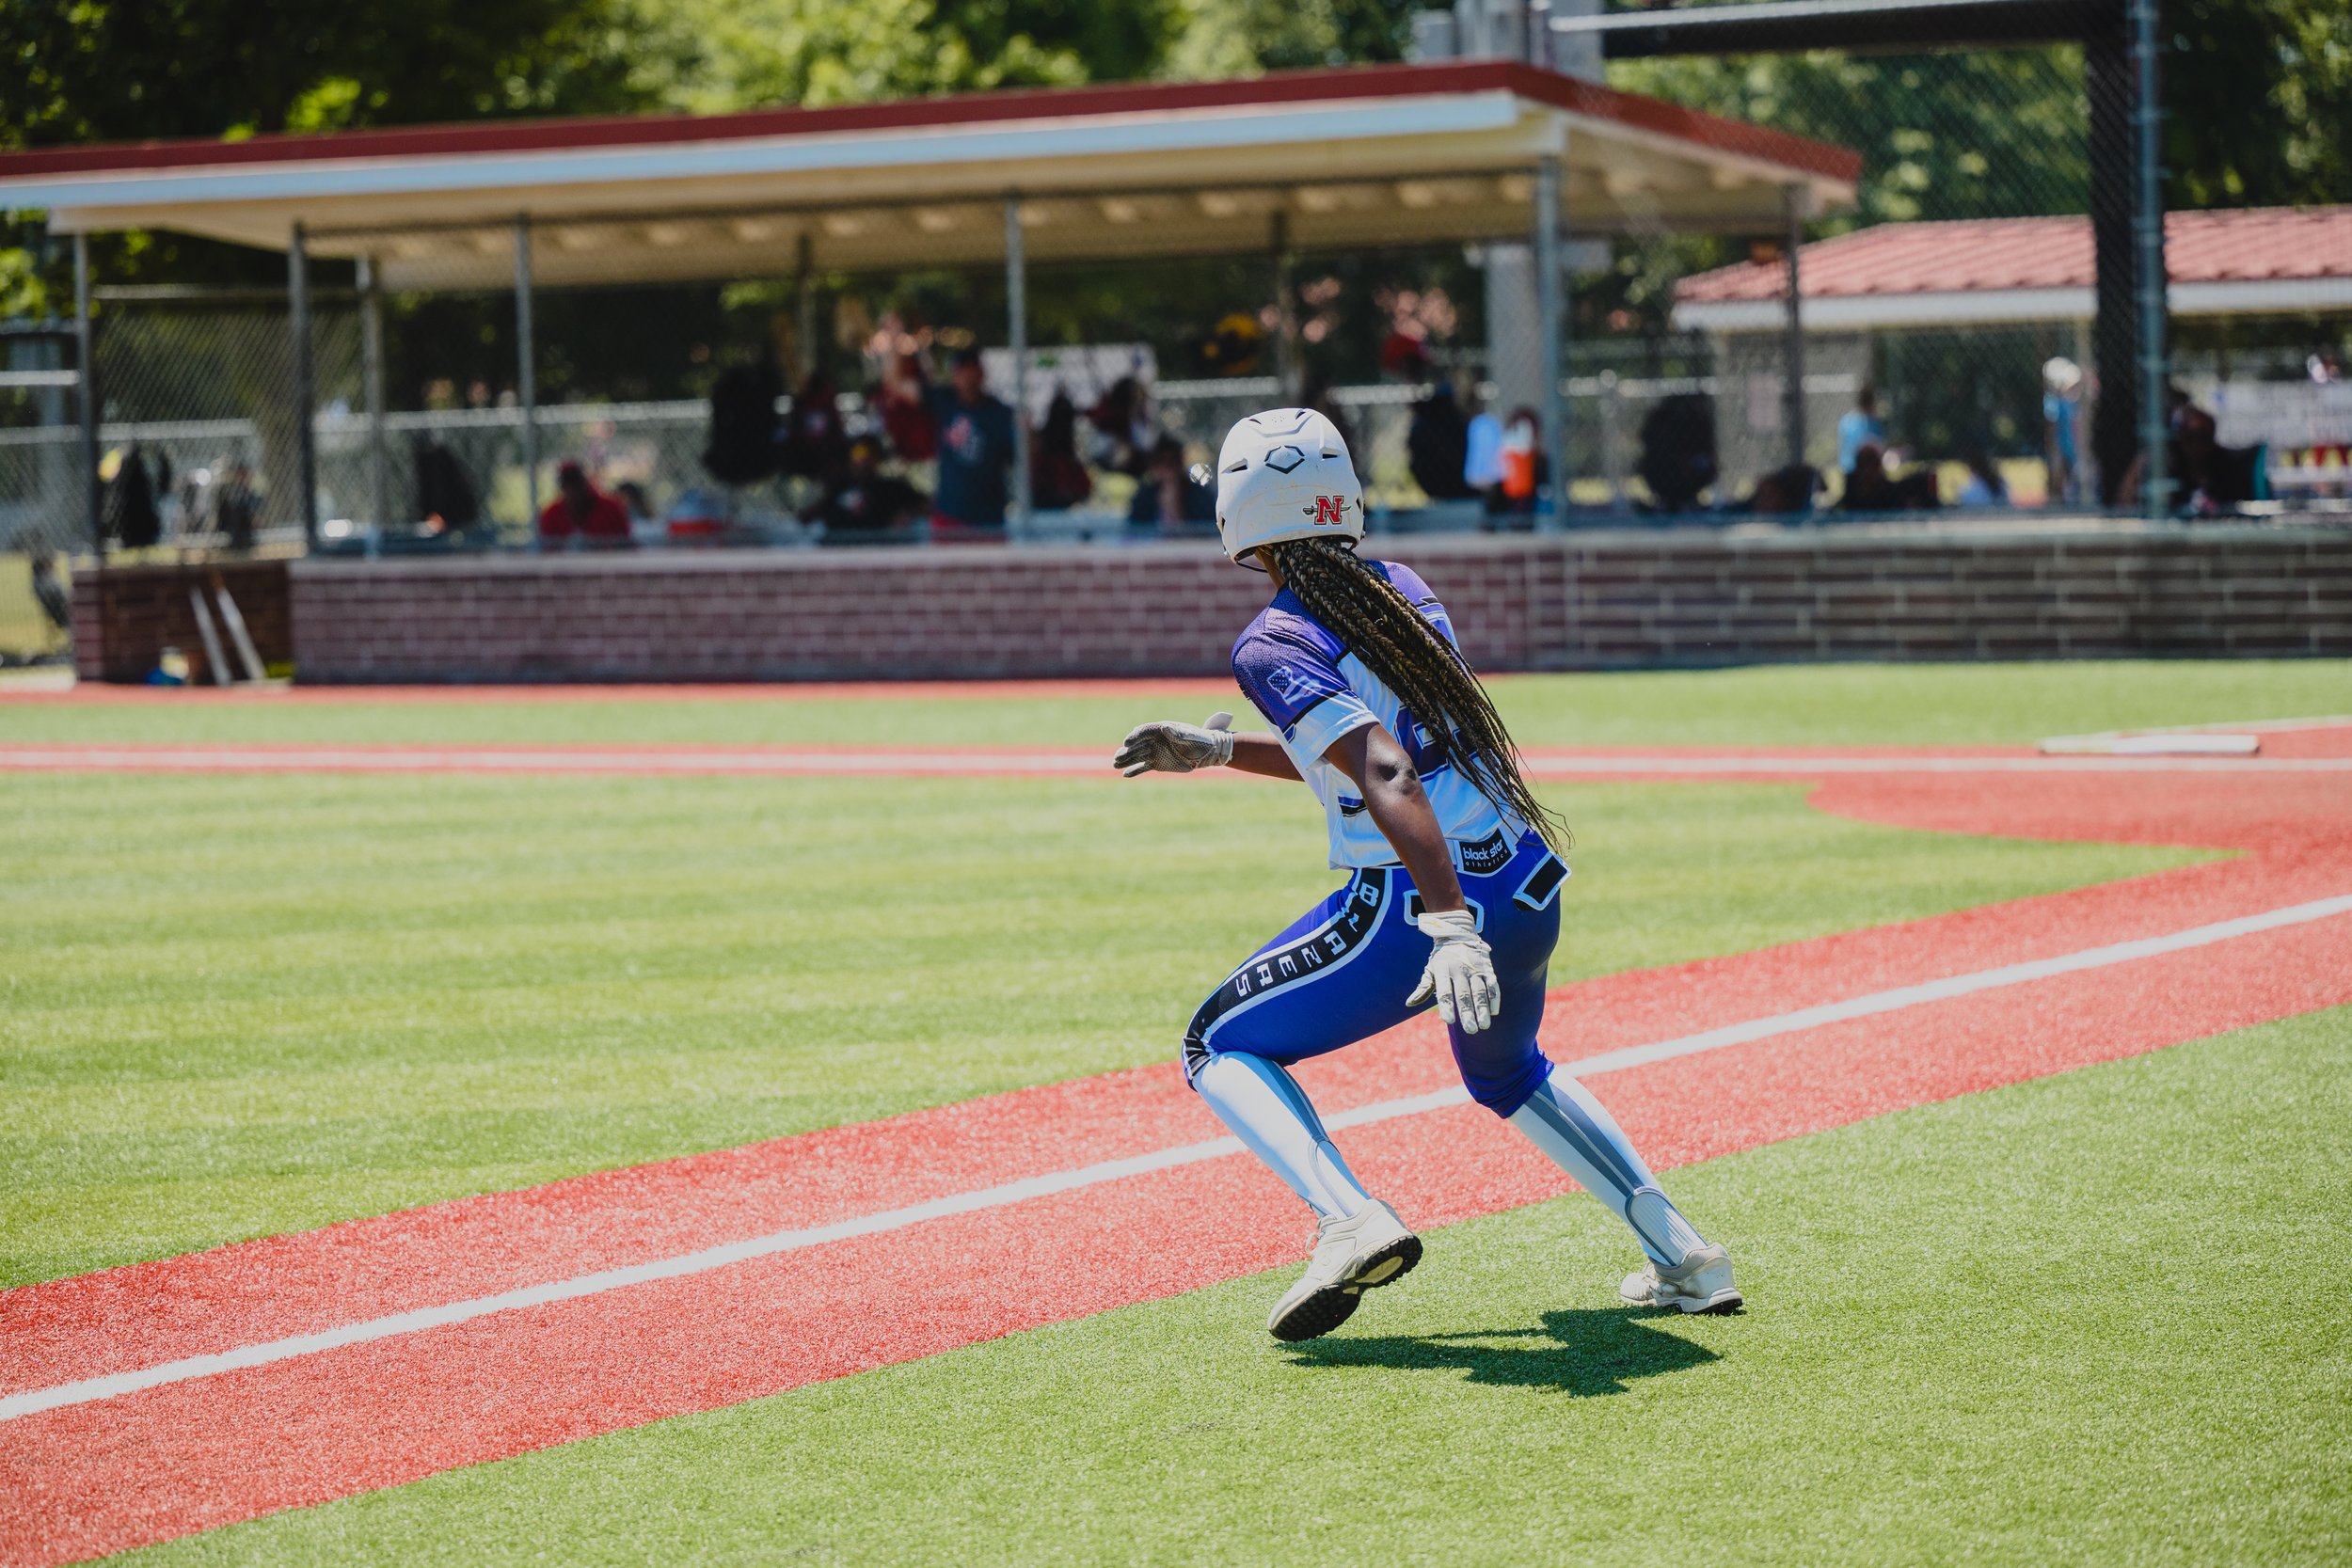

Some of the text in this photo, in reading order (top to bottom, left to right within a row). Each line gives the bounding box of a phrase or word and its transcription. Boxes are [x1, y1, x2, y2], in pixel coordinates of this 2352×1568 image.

[1314, 495, 1344, 525] N
[1462, 839, 1503, 861] black star
[1465, 849, 1508, 867] athletics
[1235, 882, 1379, 997] BLAZERS
